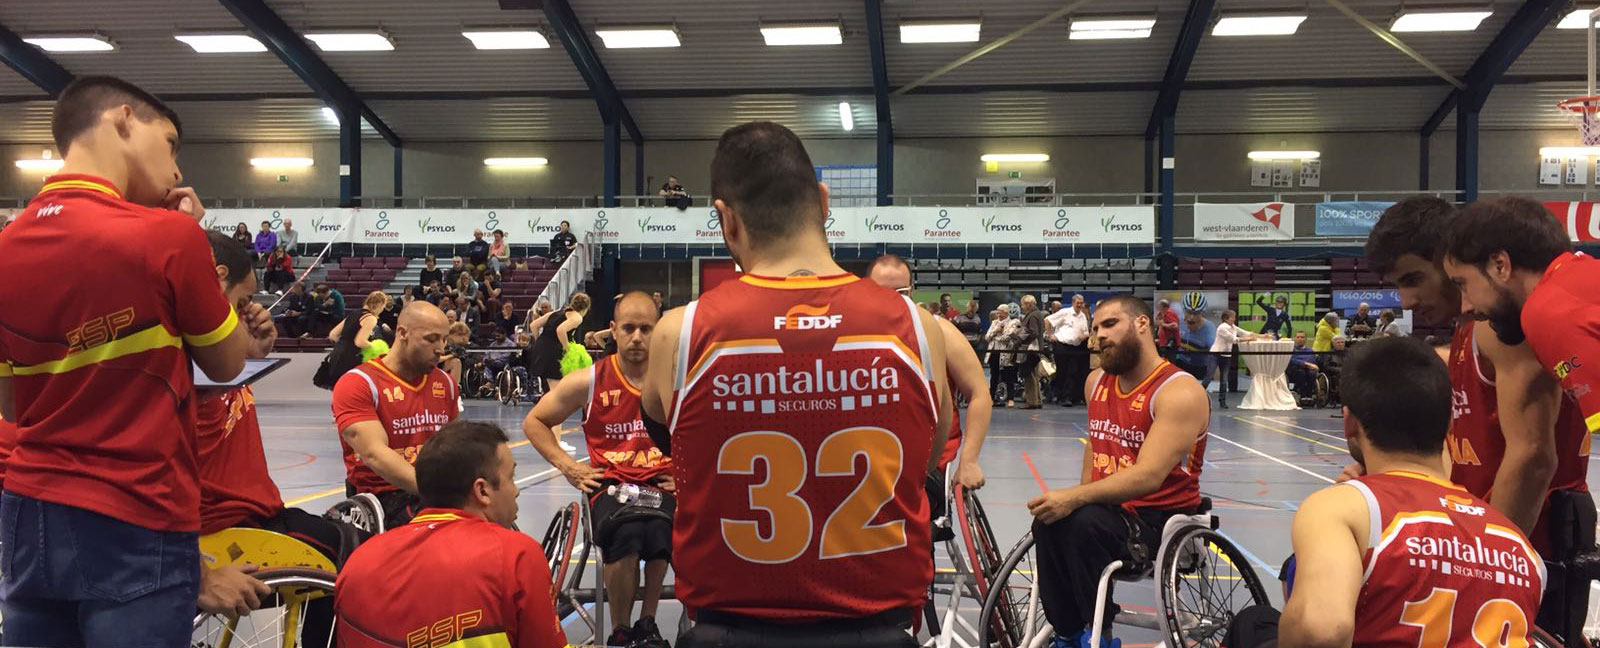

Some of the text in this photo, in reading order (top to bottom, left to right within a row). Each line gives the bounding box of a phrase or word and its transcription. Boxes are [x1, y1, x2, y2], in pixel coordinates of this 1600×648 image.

[37, 202, 64, 219] vive
[1320, 209, 1347, 219] 100%
[365, 229, 400, 238] Parantee
[427, 225, 456, 233] PSYLOS
[647, 224, 676, 232] PSYLOS
[696, 229, 722, 238] Parant
[874, 224, 905, 232] PSYLOS
[924, 229, 961, 238] Parantee
[991, 224, 1022, 232] PSYLOS
[1042, 229, 1080, 238] Parantee
[1110, 223, 1142, 232] PSYLOS
[1202, 223, 1269, 233] west-vlaanderen
[774, 313, 843, 332] FEDDF
[713, 357, 900, 398] santalucía
[383, 385, 405, 403] 14
[600, 389, 622, 407] 17
[777, 399, 837, 415] SEGUROS
[393, 409, 449, 430] santalucía
[605, 419, 647, 434] santa
[717, 427, 908, 565] 32
[1405, 536, 1530, 577] santalucía
[1453, 564, 1493, 581] SEGUROS
